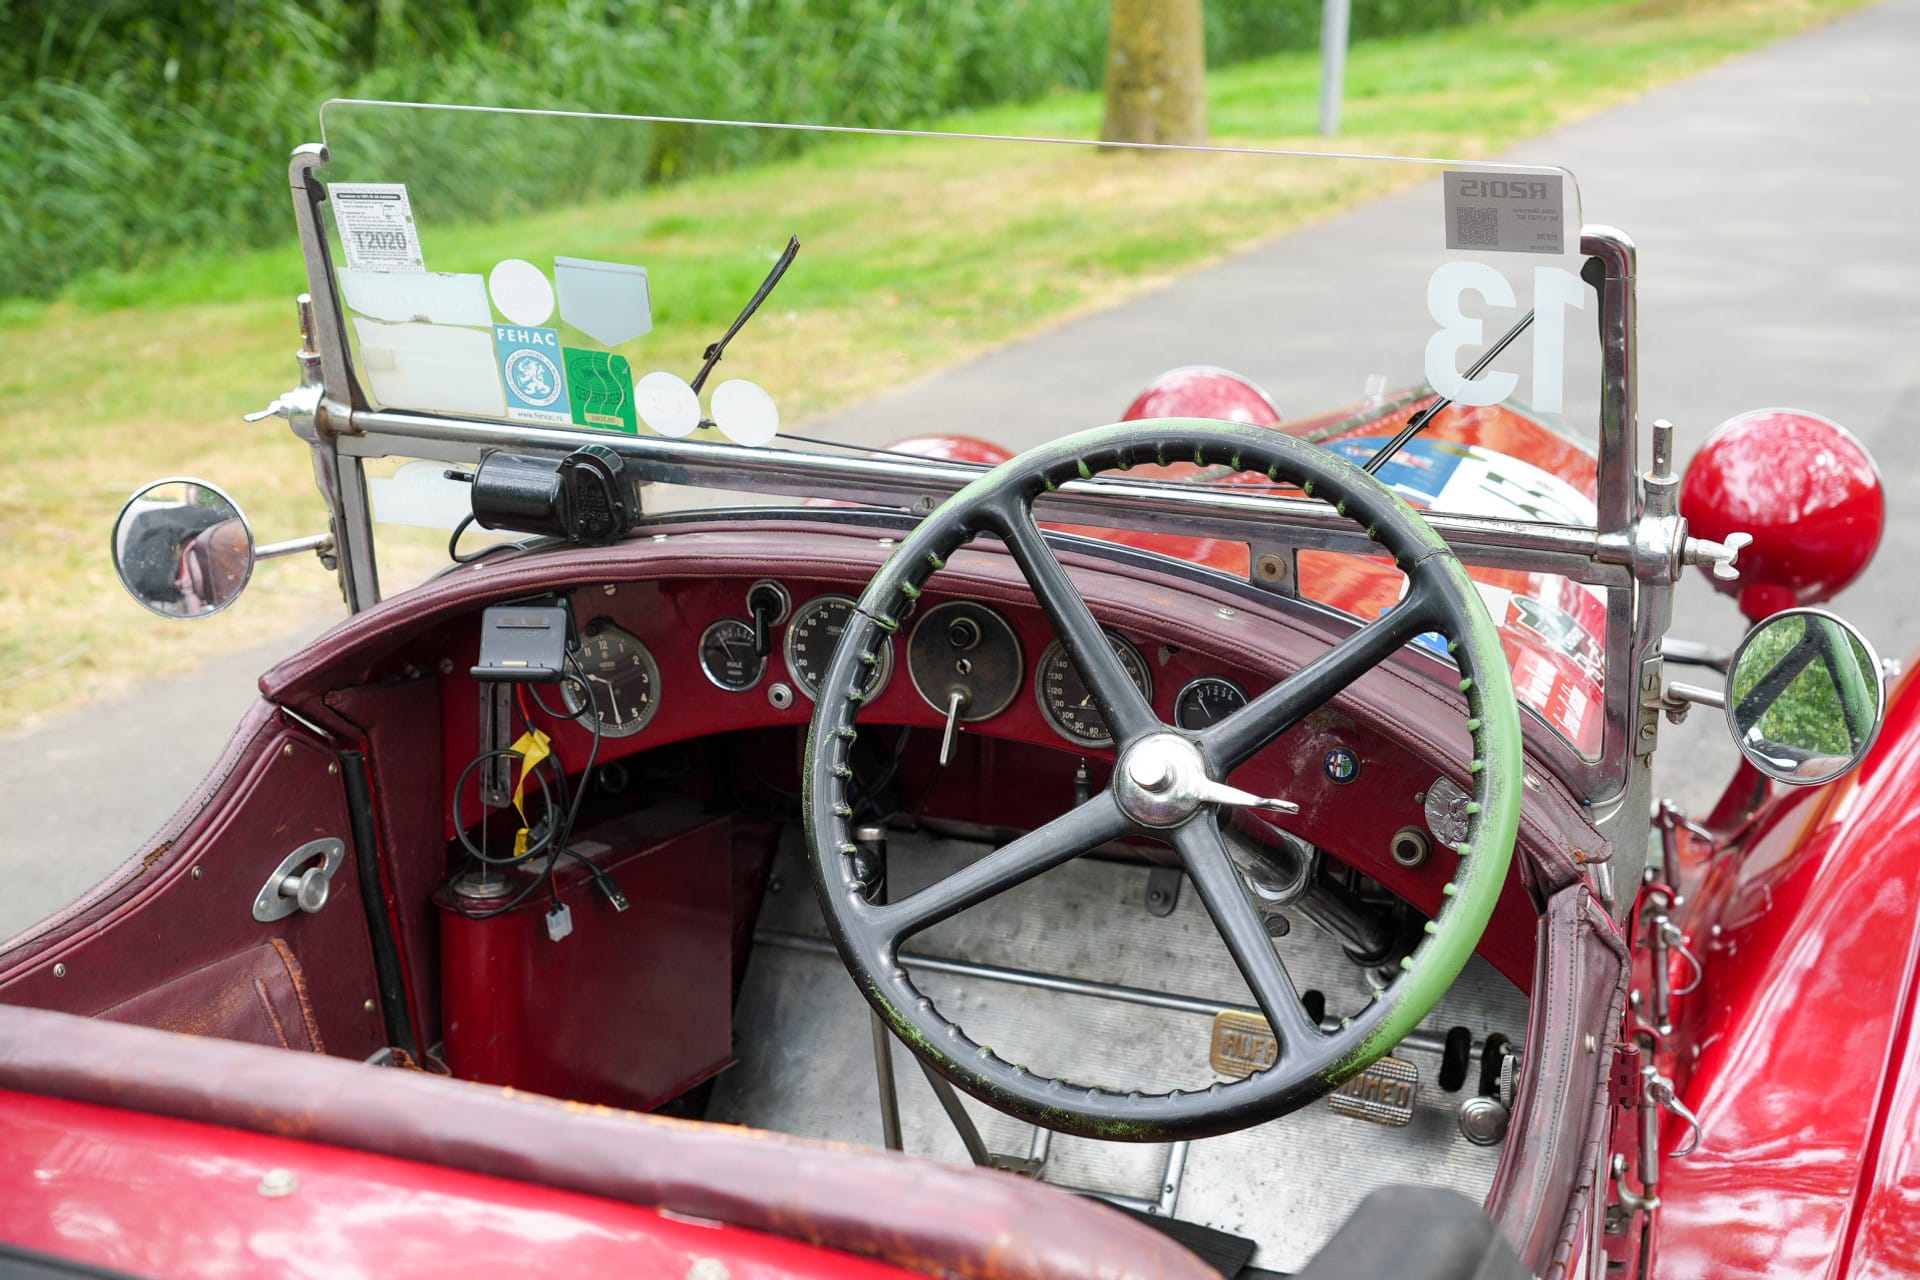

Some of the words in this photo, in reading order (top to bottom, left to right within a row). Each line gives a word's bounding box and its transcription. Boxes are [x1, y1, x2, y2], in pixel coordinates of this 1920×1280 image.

[350, 231, 407, 250] T2020
[496, 327, 556, 346] FEHAC
[820, 611, 829, 619] 70
[807, 618, 817, 627] 65
[799, 629, 809, 637] 60
[599, 640, 608, 650] 12
[619, 643, 624, 653] 1
[584, 647, 592, 657] 11
[632, 655, 640, 665] 2
[798, 659, 808, 667] 50
[1056, 660, 1067, 669] 140
[642, 673, 649, 683] 3
[1051, 672, 1063, 680] 130
[574, 681, 581, 692] 9
[1051, 687, 1063, 695] 120
[640, 692, 648, 702] 4
[1055, 700, 1065, 708] 110
[598, 711, 604, 721] 7
[631, 707, 638, 718] 5
[1062, 711, 1074, 720] 100
[1074, 721, 1084, 729] 90
[1089, 727, 1099, 735] 80
[1221, 1030, 1278, 1063] ALFA
